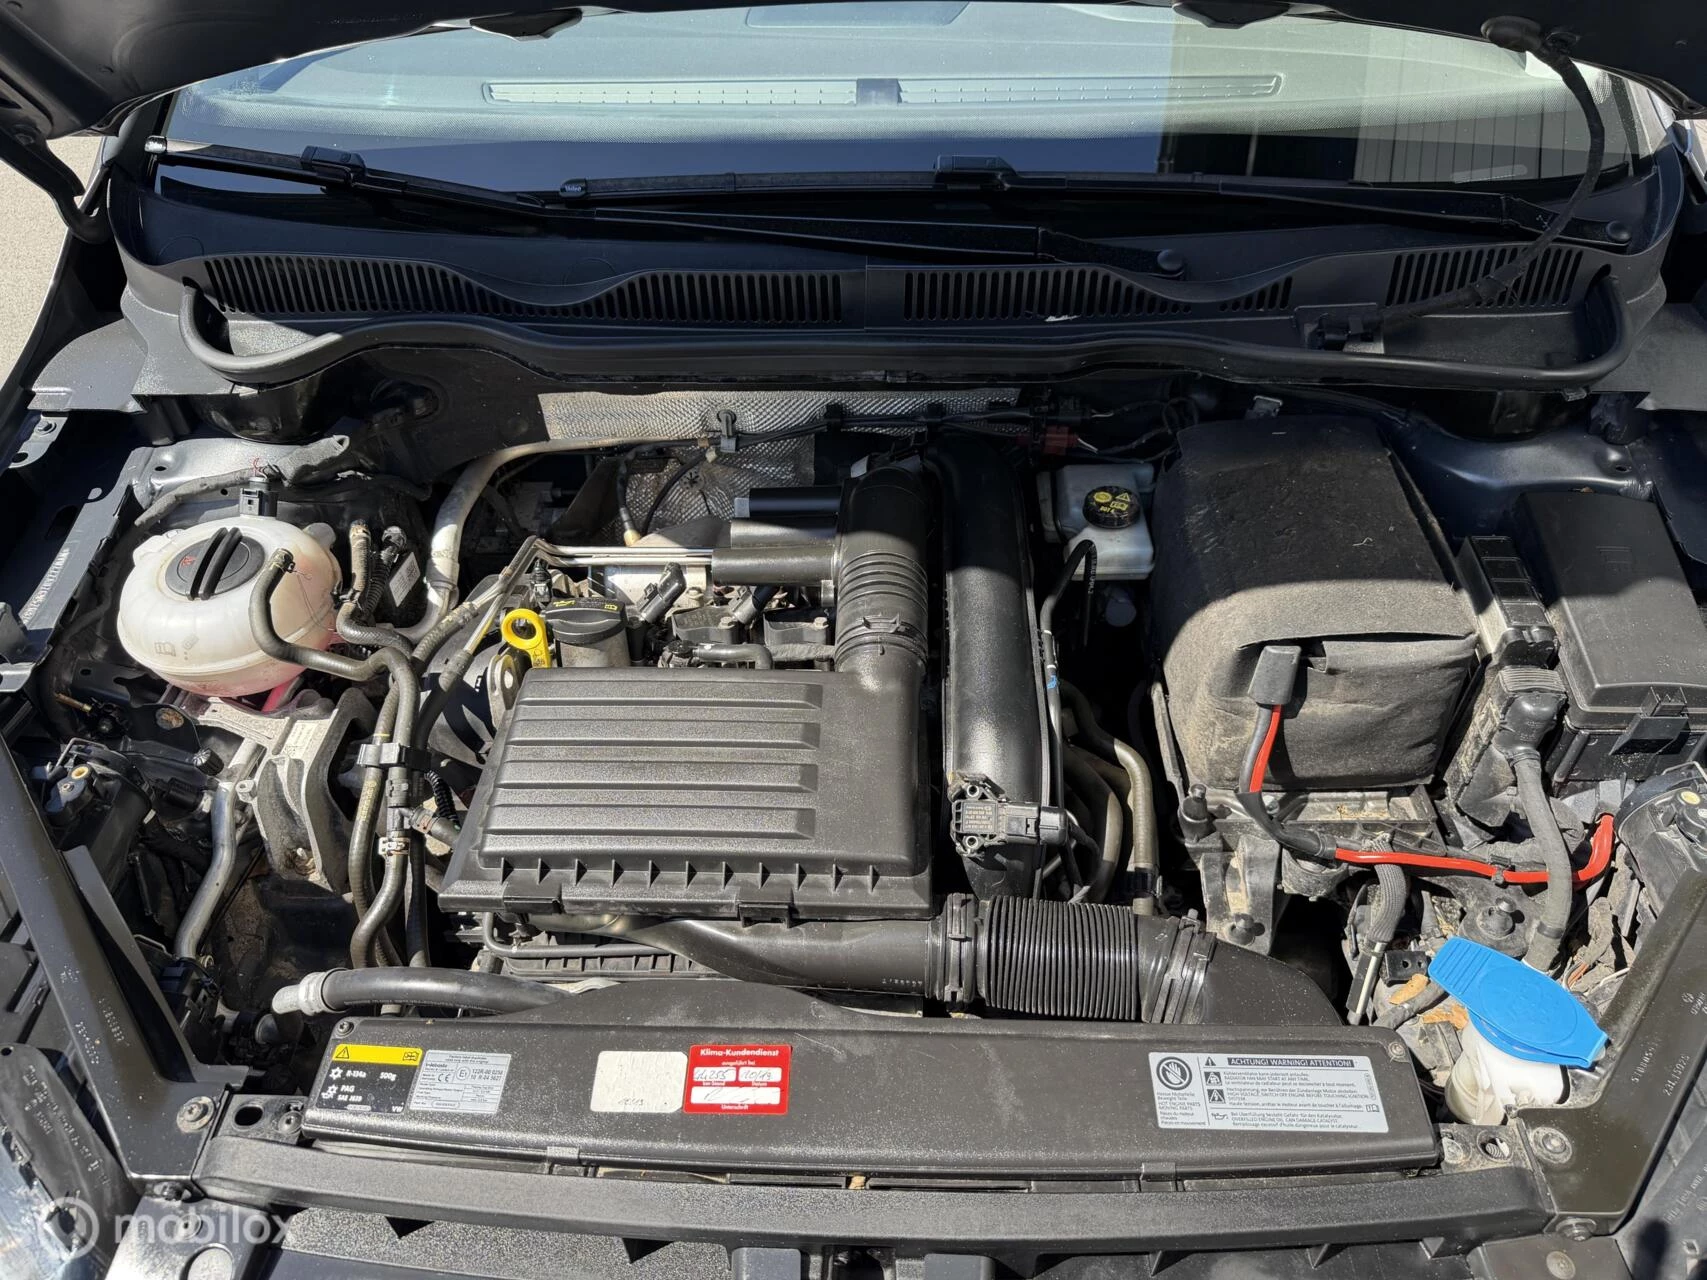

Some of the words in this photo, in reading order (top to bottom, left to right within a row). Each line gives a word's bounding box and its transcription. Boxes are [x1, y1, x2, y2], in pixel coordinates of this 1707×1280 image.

[700, 1048, 779, 1057] Klima-Kundendienst
[380, 1071, 398, 1082] 500g
[340, 1085, 355, 1093] PAG
